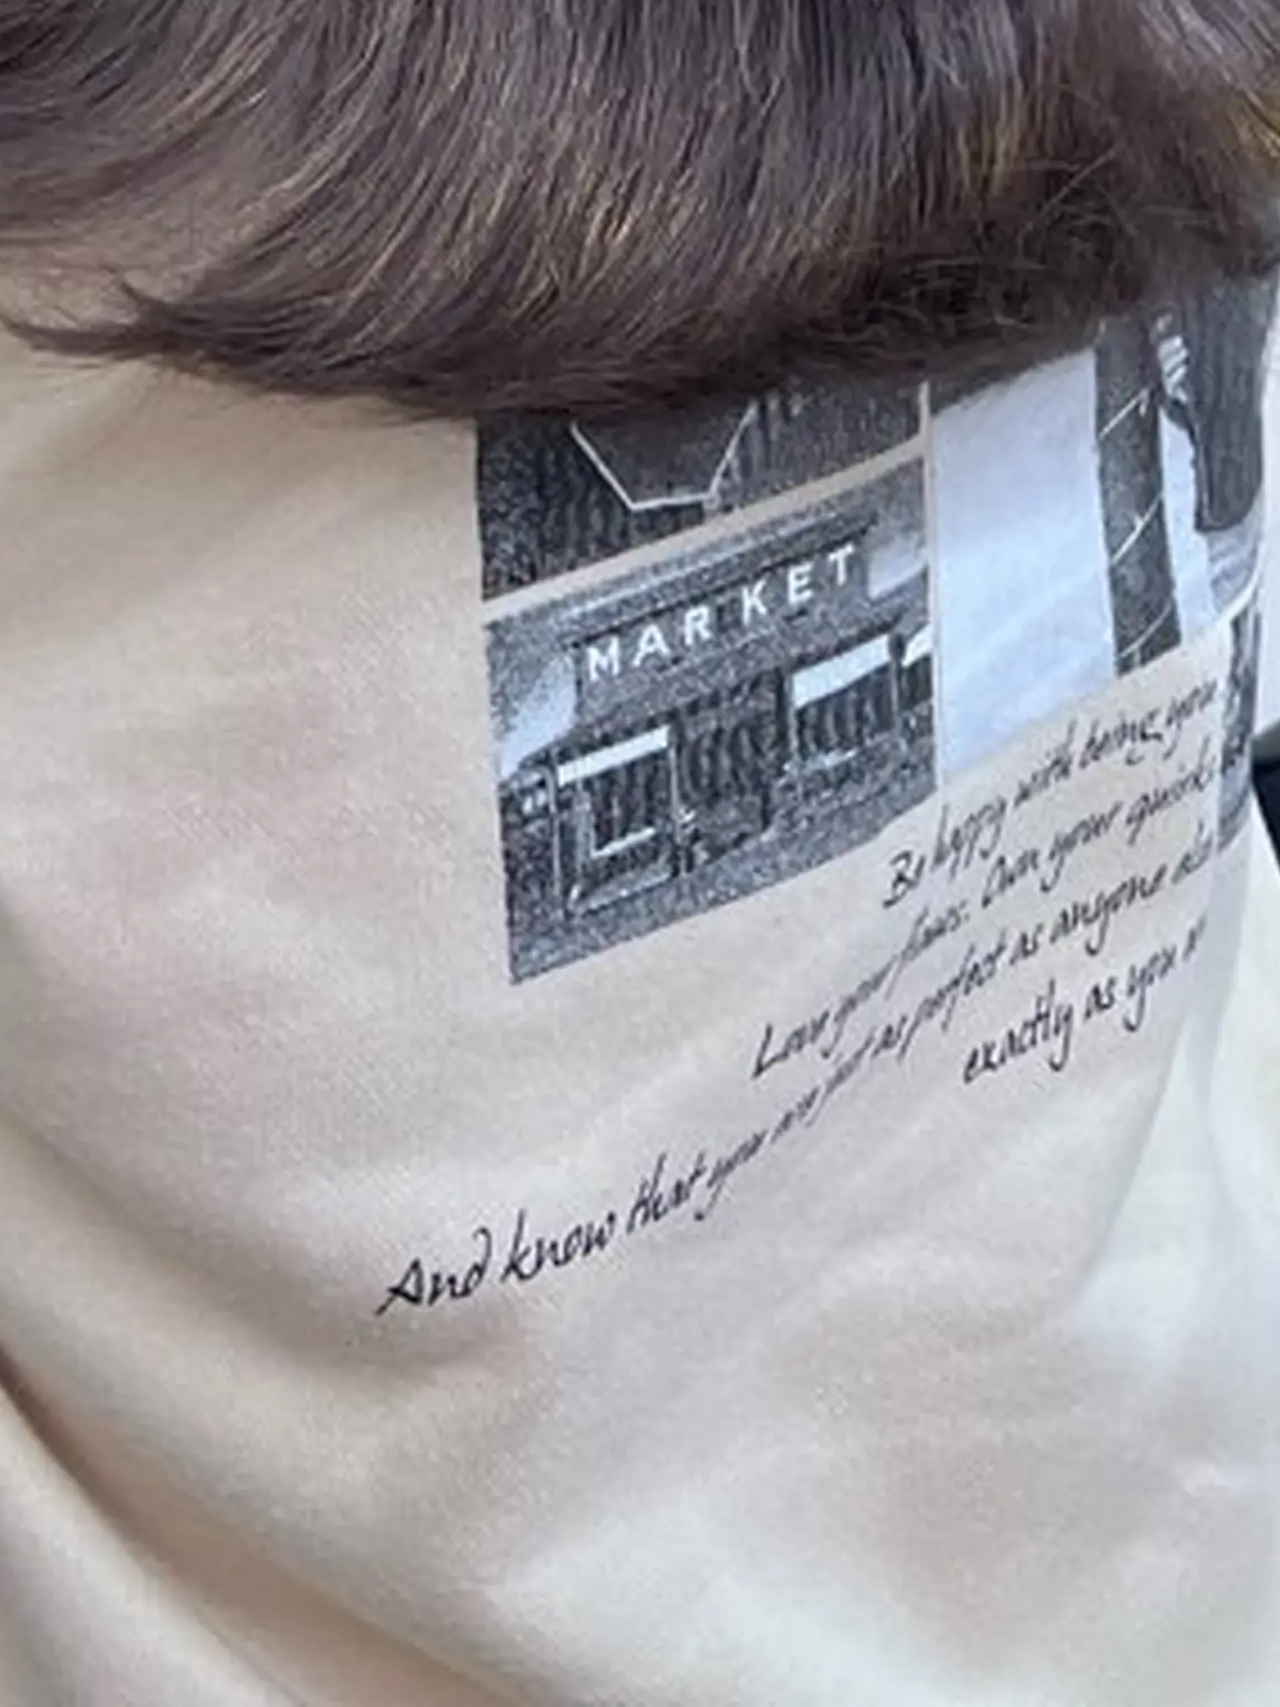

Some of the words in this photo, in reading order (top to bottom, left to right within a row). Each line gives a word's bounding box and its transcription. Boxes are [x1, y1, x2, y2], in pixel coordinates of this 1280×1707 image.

[587, 544, 855, 681] MARKET
[883, 850, 926, 908] Be
[931, 803, 1008, 880] happy
[1014, 719, 1078, 808] with
[1079, 707, 1163, 766] being
[751, 1009, 829, 1079] Love
[1040, 801, 1123, 893] your
[963, 976, 1073, 1084] exactly
[1083, 975, 1117, 1023] as
[1122, 942, 1178, 1033] you
[375, 1227, 493, 1315] And
[500, 1207, 617, 1284] know
[626, 1150, 707, 1235] that
[693, 1128, 768, 1222] you
[870, 1015, 908, 1060] as
[1009, 921, 1044, 965] as
[1048, 862, 1168, 956] anyone
